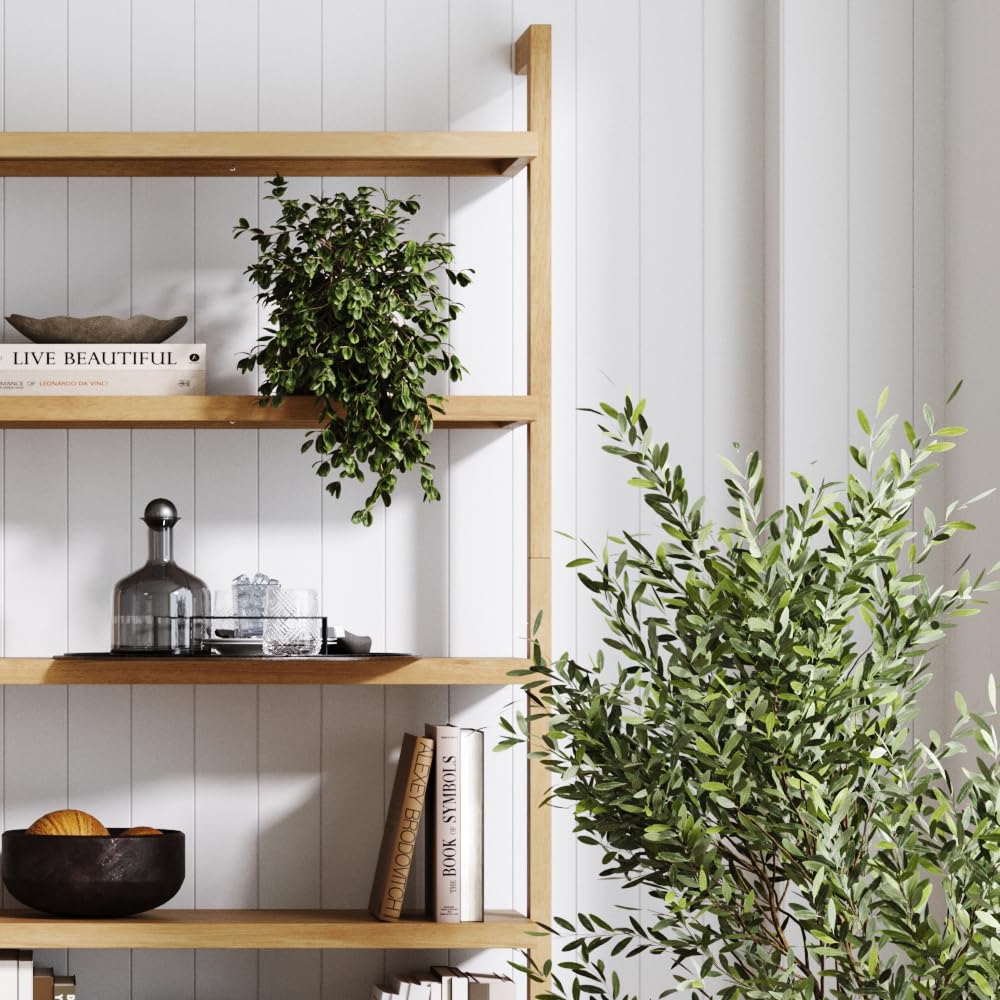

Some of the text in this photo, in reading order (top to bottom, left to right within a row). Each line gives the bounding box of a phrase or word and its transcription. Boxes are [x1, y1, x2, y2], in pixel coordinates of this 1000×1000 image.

[12, 351, 178, 365] LIVE BEAUTIFUL
[442, 755, 457, 823] SYMBOLS
[385, 742, 433, 912] ALEXEY BRODOVITCH
[450, 827, 457, 835] OF
[442, 839, 457, 876] BOOK
